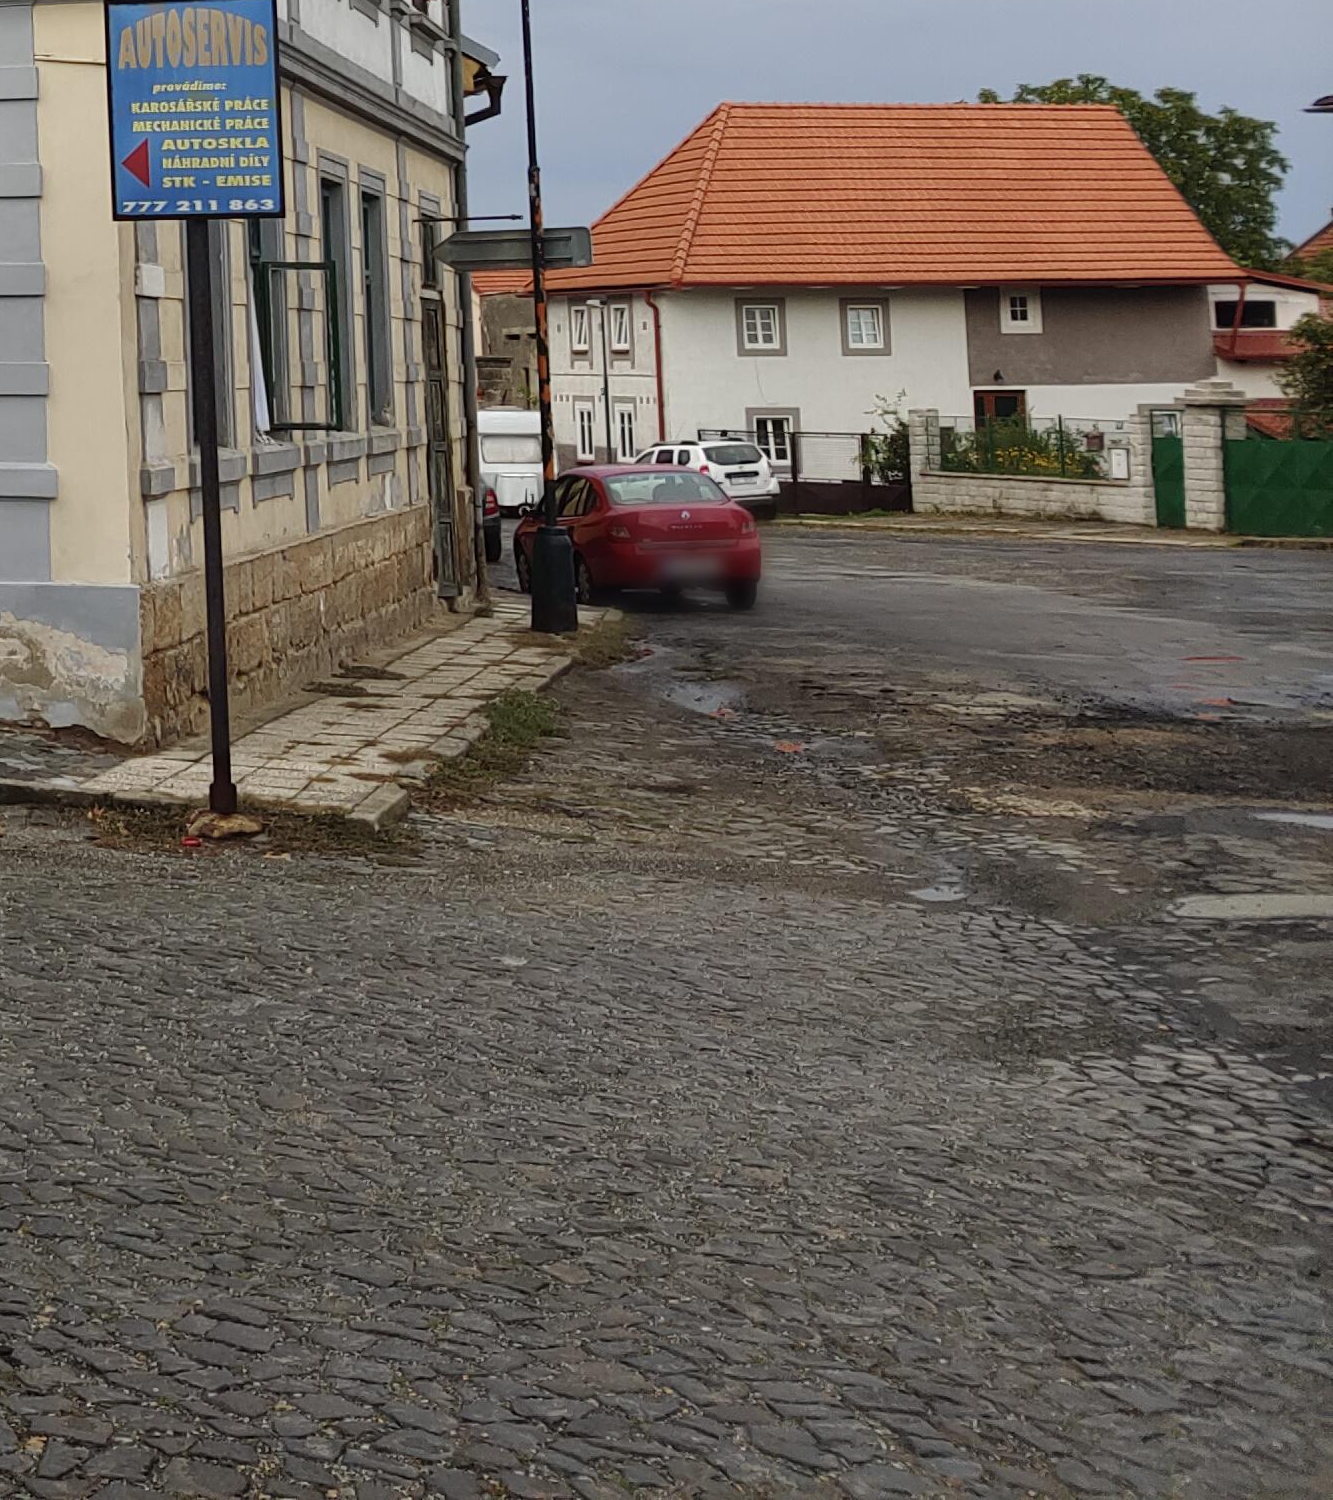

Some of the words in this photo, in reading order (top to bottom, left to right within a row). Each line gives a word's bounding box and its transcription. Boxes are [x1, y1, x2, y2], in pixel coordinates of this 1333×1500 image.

[118, 7, 269, 69] AUTOSERVIS
[131, 98, 220, 114] KAROSÁŘSKÉ
[225, 97, 270, 111] PRÁCE
[132, 117, 222, 132] MECHANICKÉ
[225, 116, 270, 130] PRÁCE
[161, 137, 270, 150] AUTOSKLA
[162, 154, 235, 169] NÁHRADNÍ
[162, 177, 196, 188] STK
[216, 174, 272, 187] EMISE
[122, 201, 168, 213] 777
[176, 200, 218, 211] 211
[228, 199, 274, 211] 863
